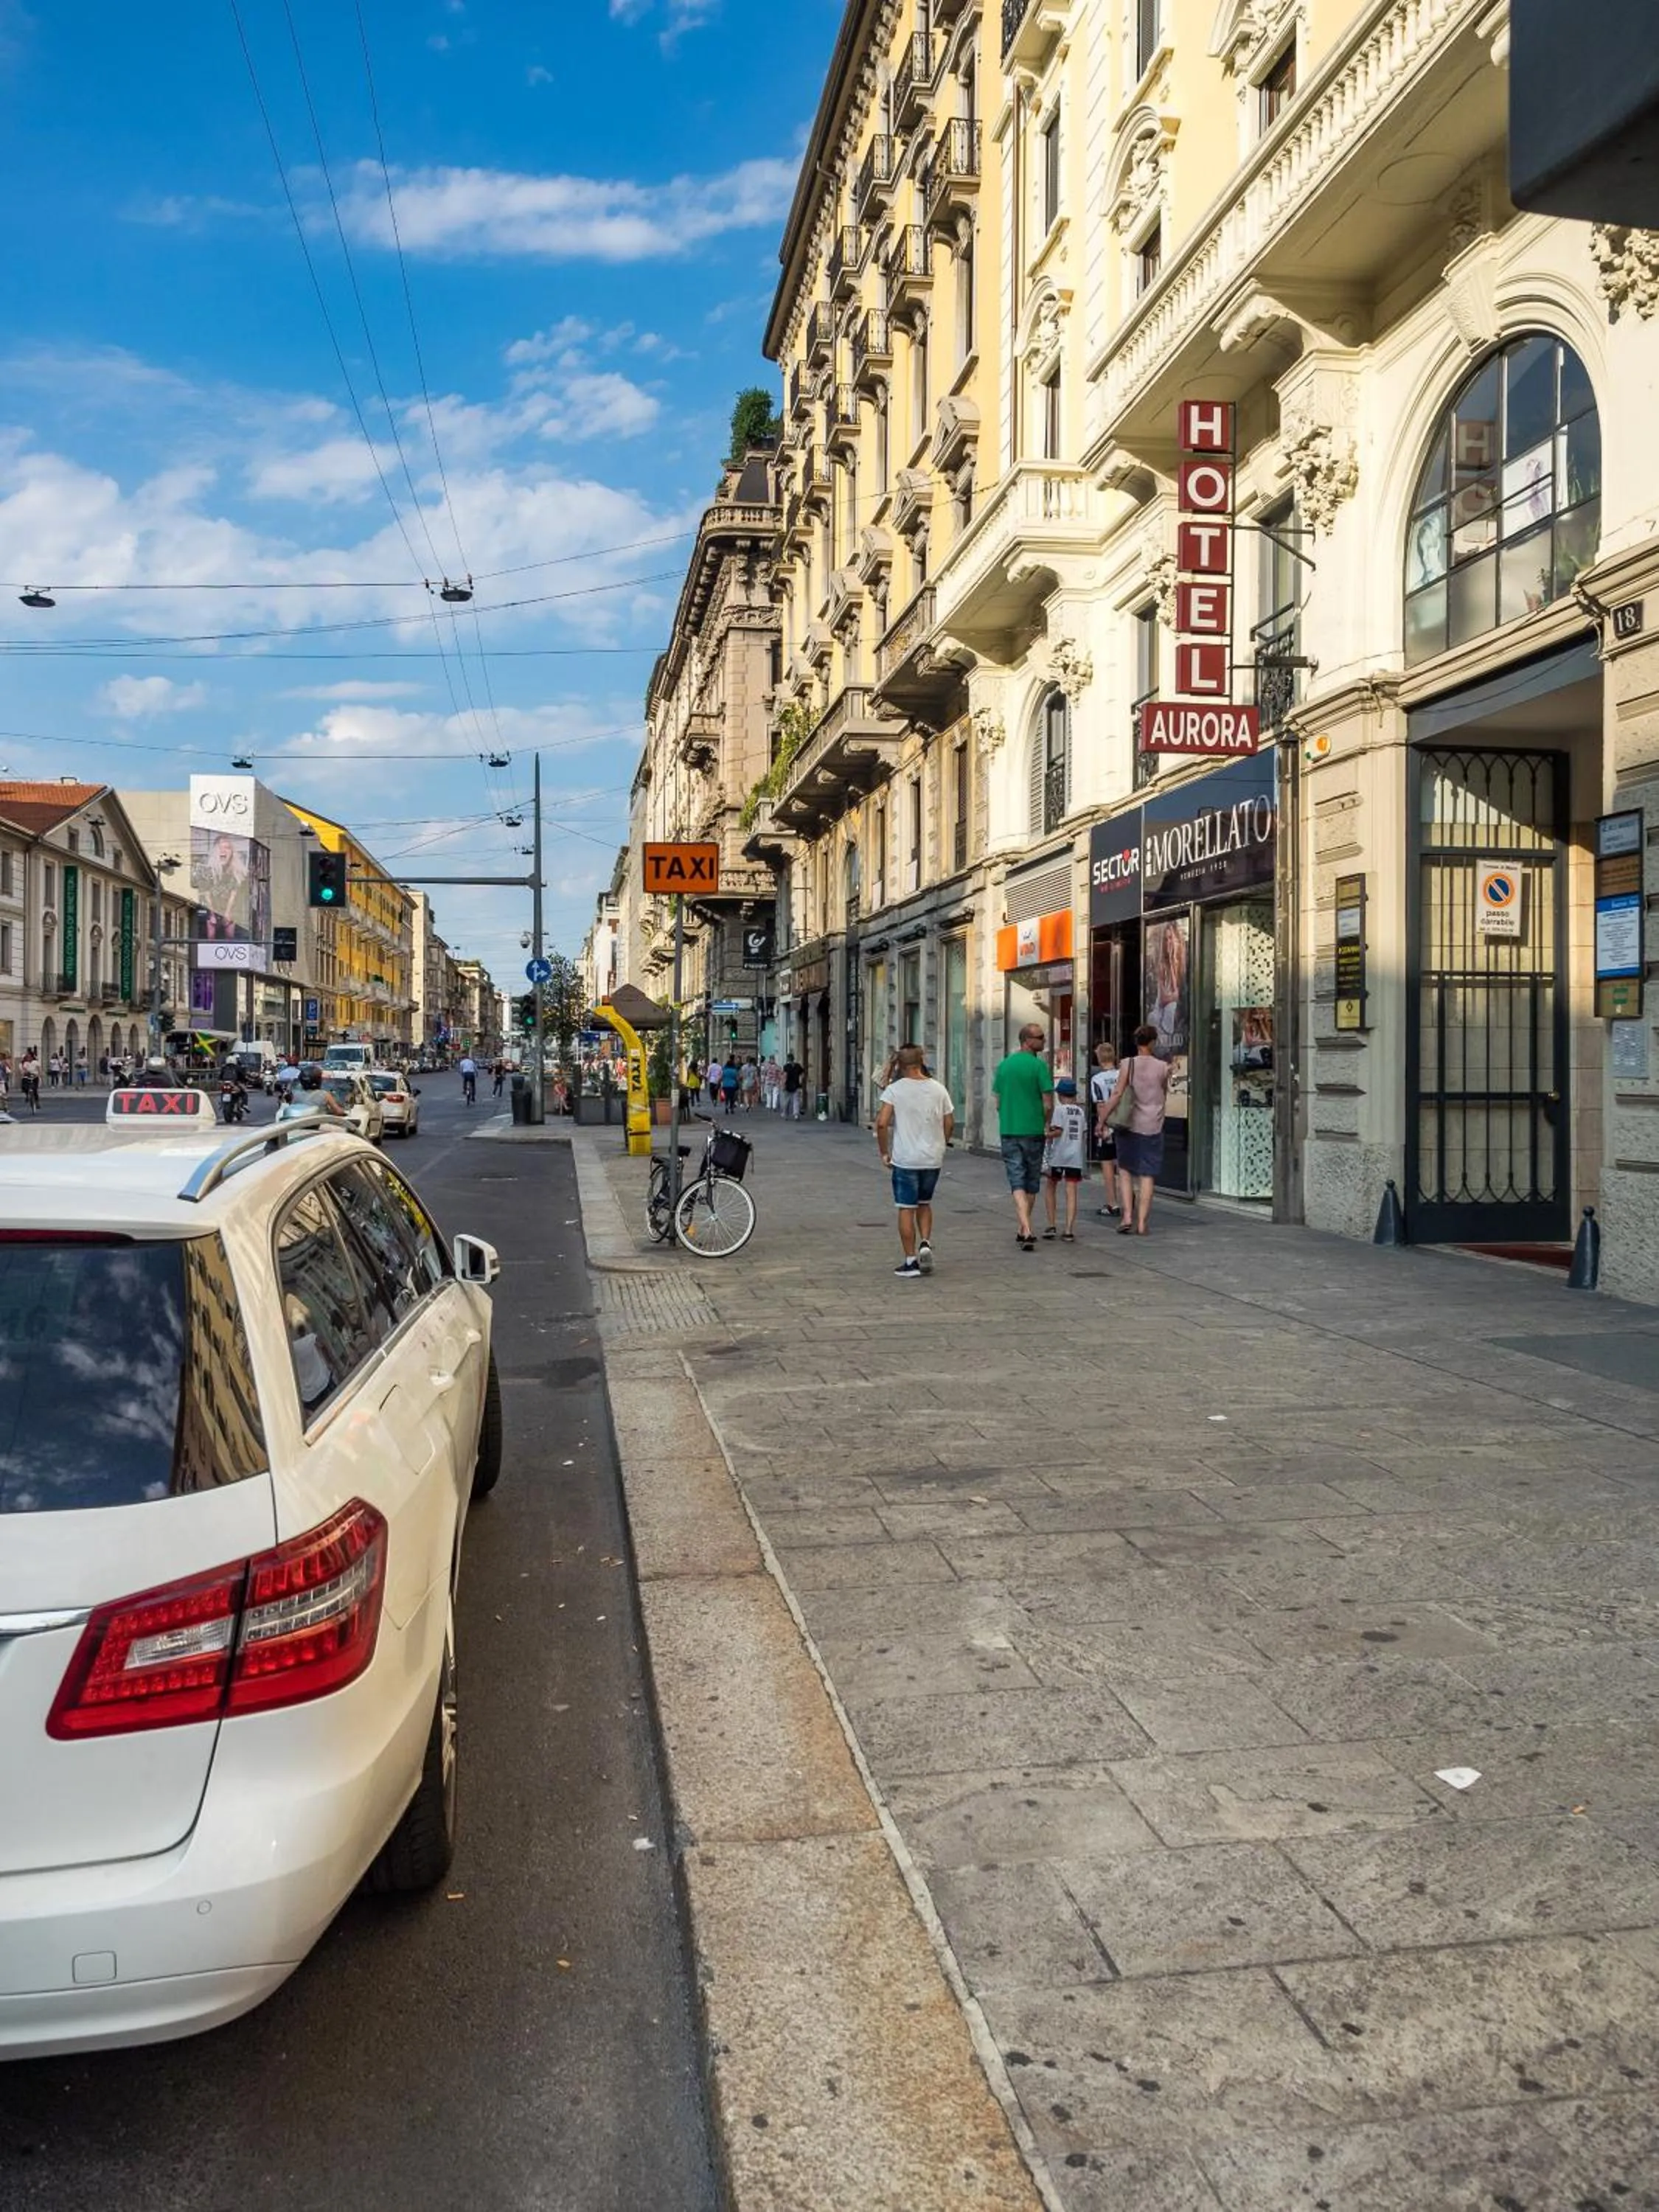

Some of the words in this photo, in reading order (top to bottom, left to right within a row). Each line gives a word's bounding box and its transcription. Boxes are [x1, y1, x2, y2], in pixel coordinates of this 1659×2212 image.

[1187, 405, 1225, 689] HOTEL
[1617, 607, 1635, 631] 18
[1150, 711, 1253, 748] AURORA
[199, 793, 248, 814] OVS
[1151, 795, 1272, 877] MORELLATO
[649, 857, 714, 880] TAXI
[1093, 847, 1140, 885] SECTOR
[215, 946, 247, 961] OVS
[631, 1058, 641, 1092] TAXI
[117, 1093, 195, 1114] TAXI
